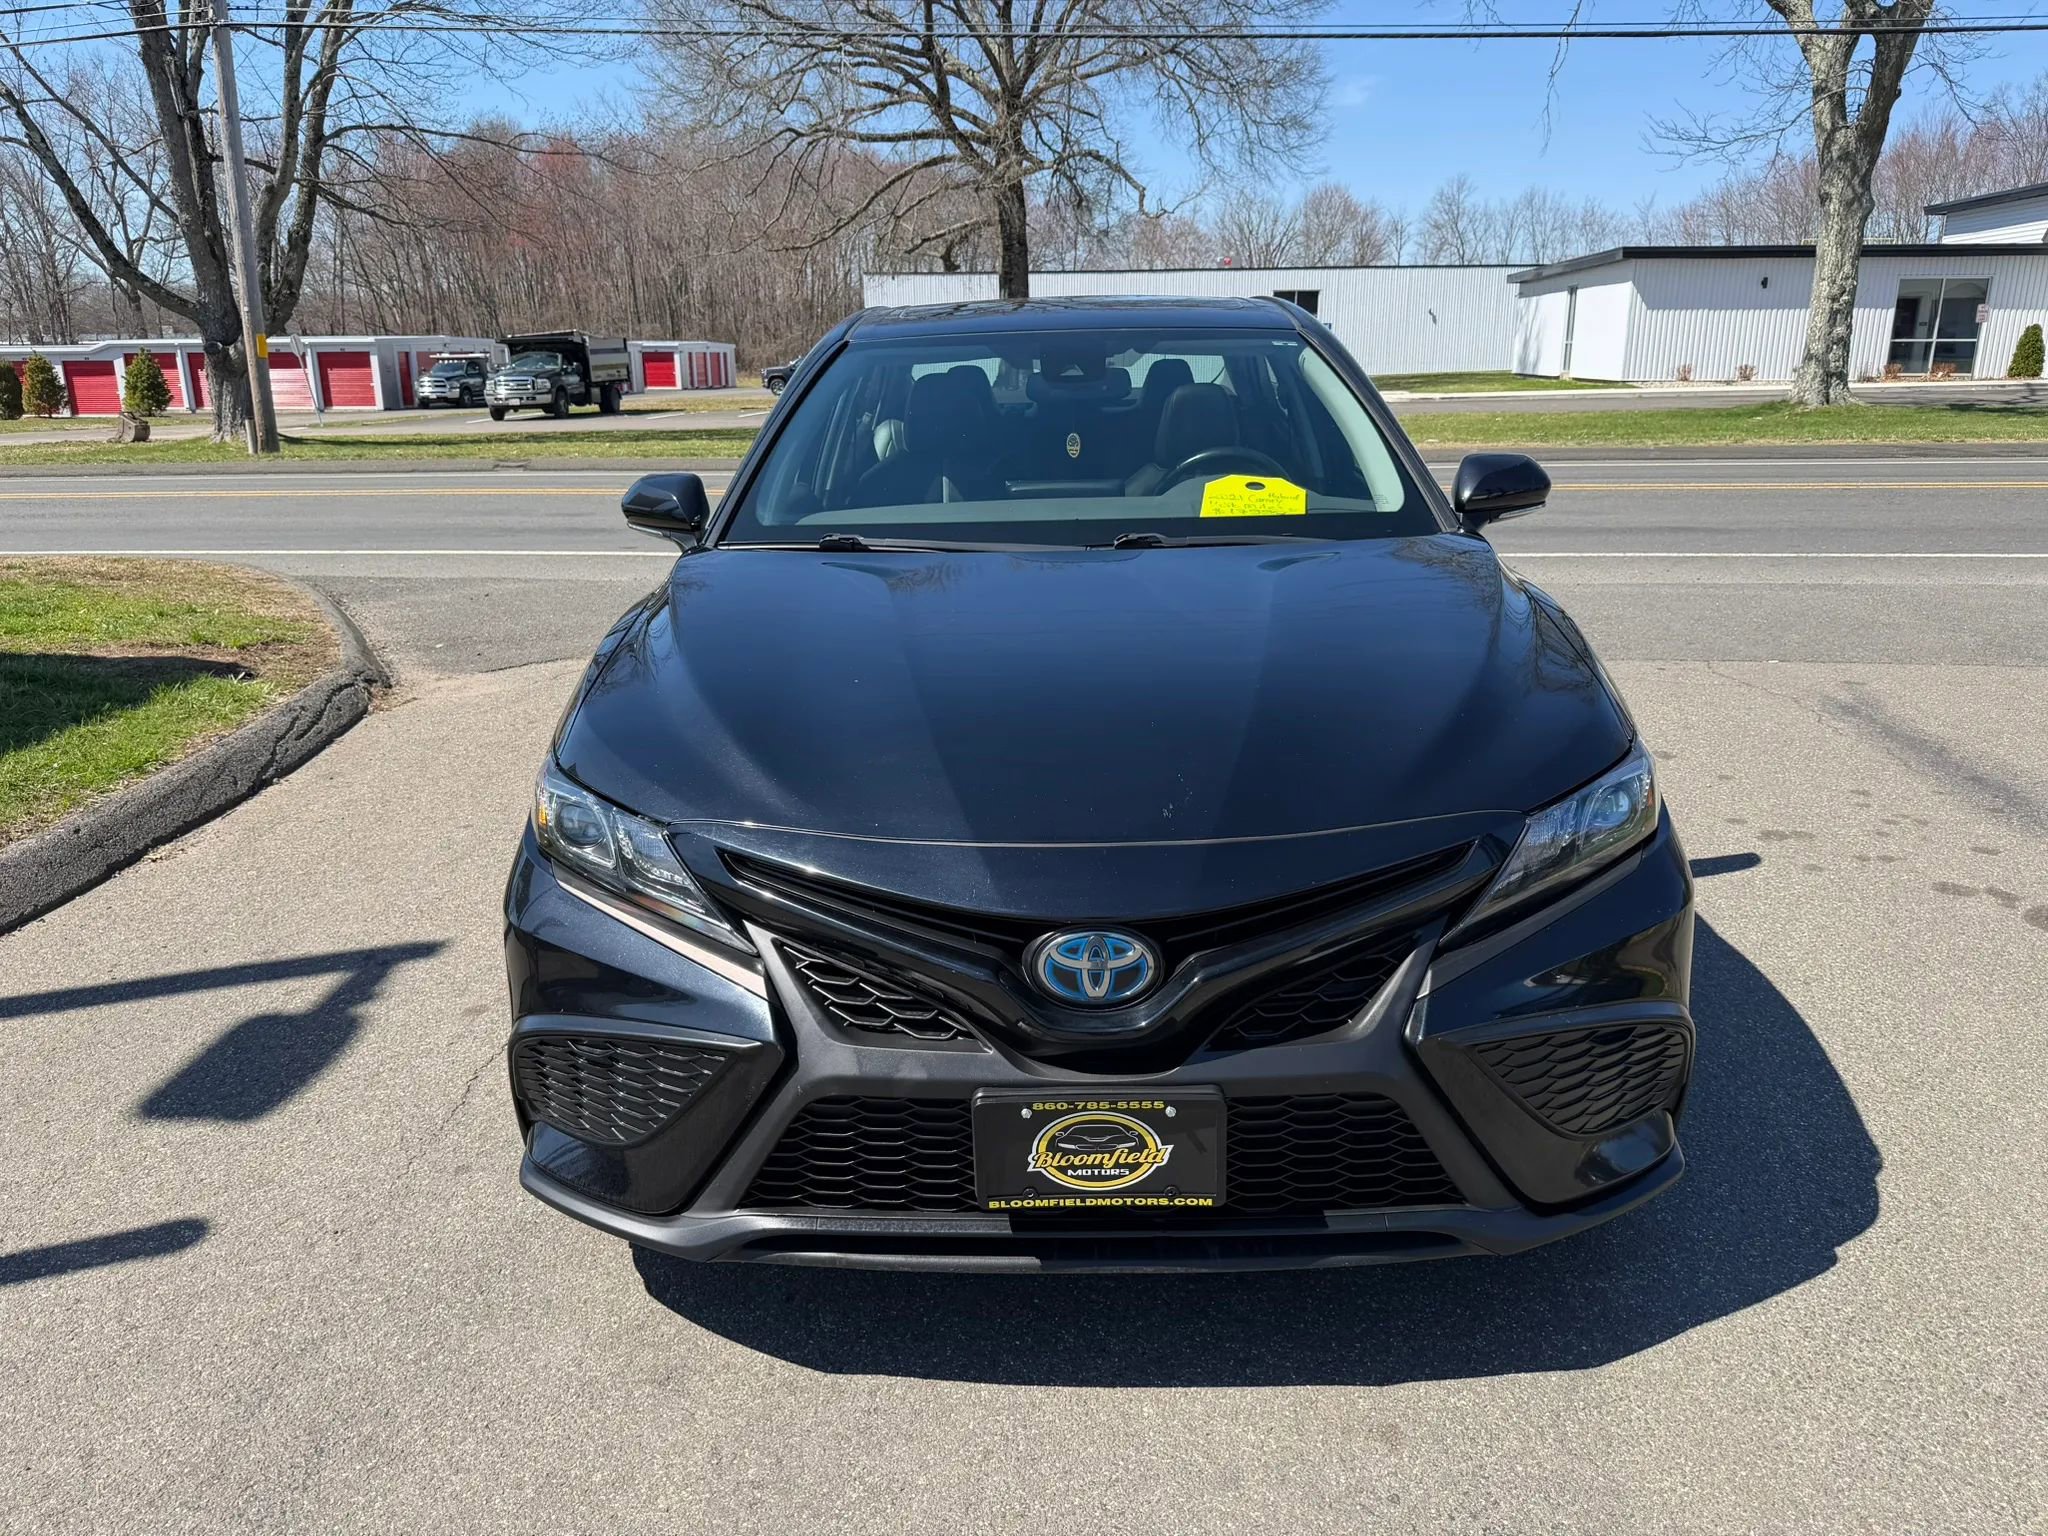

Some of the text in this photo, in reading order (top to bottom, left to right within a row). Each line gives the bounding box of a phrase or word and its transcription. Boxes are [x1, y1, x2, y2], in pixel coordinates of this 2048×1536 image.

[1032, 1101, 1165, 1111] 860-785-5555
[1034, 1148, 1168, 1169] Bloomfield
[1067, 1168, 1130, 1176] MOTORS
[988, 1198, 1213, 1209] BLOOMFIELDMOTORS.COM
